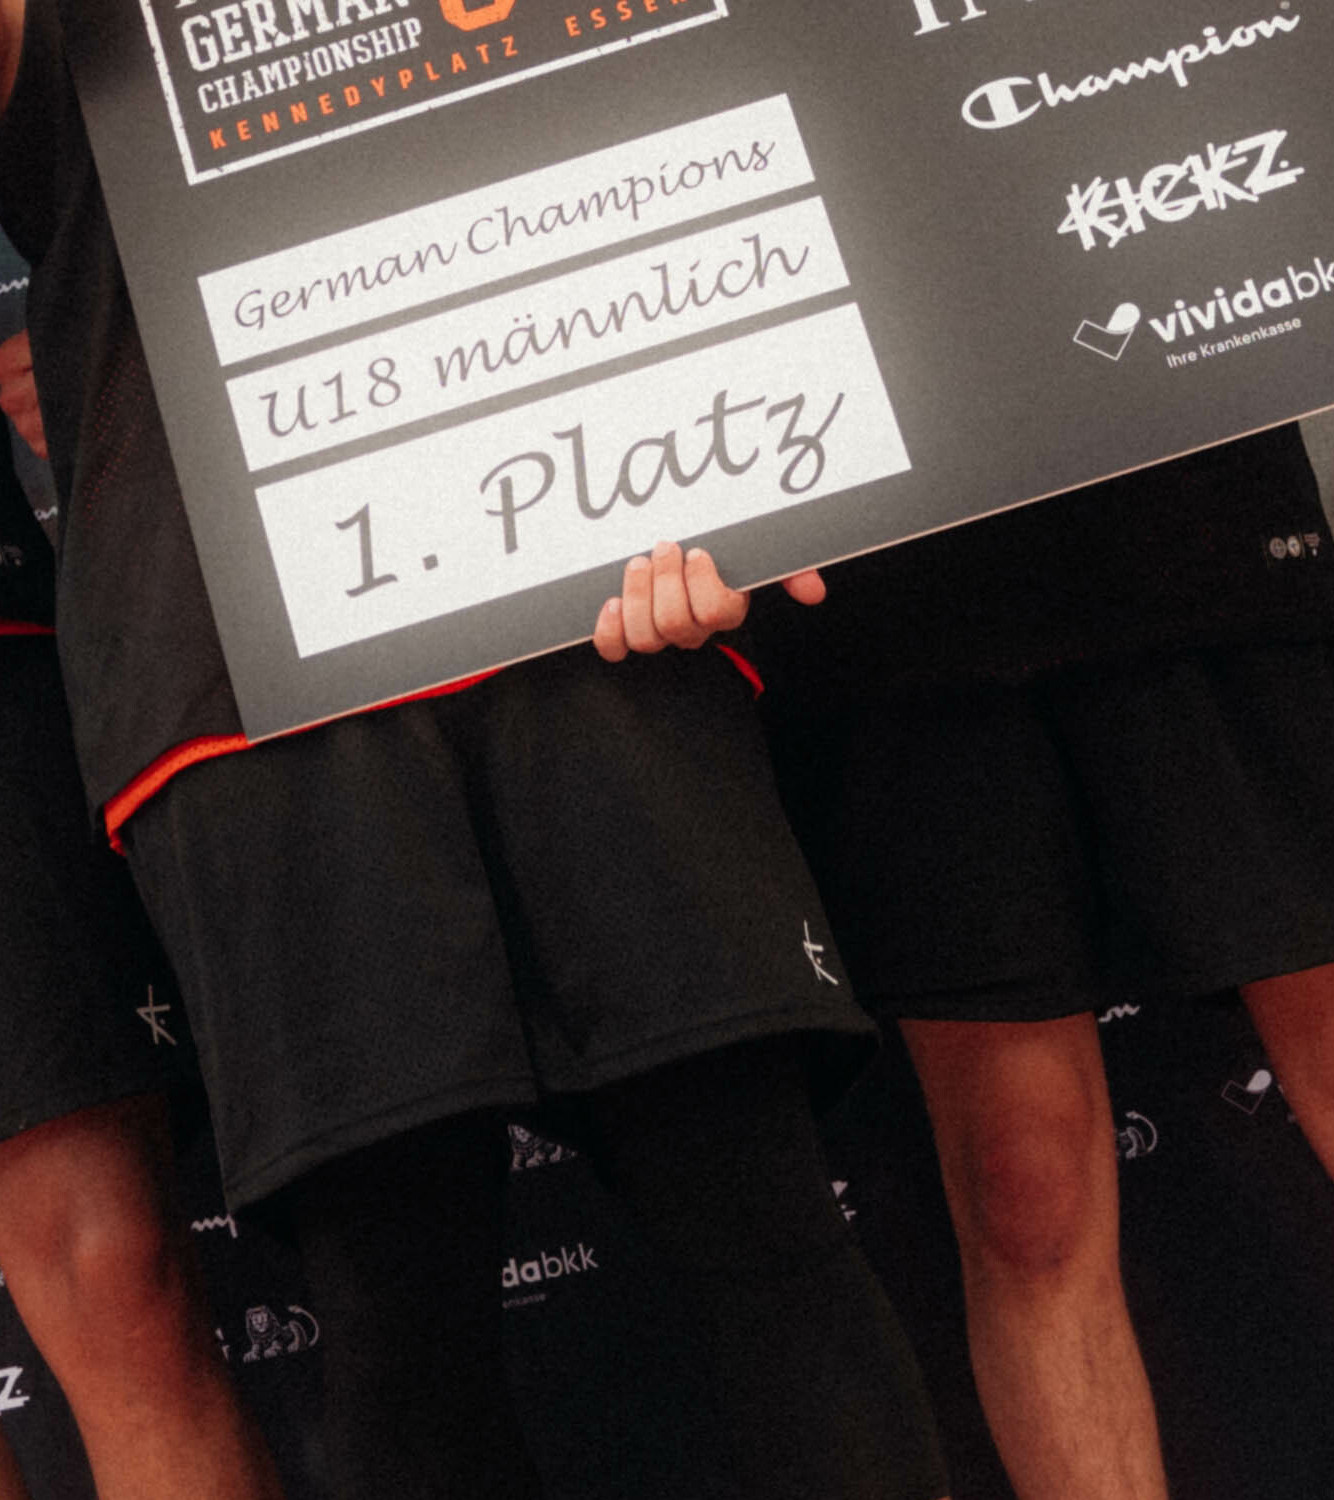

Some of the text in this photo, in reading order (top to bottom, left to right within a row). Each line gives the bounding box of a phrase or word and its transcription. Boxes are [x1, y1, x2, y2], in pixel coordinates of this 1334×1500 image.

[209, 36, 519, 149] KENNEDYPLATZ
[961, 6, 1300, 130] Champion
[233, 134, 775, 330] German Champions
[258, 233, 811, 439] U18 männlich
[1166, 316, 1302, 370] Ihre Krankenkasse
[334, 387, 846, 598] 1. Platz
[502, 1242, 599, 1288] dabkk
